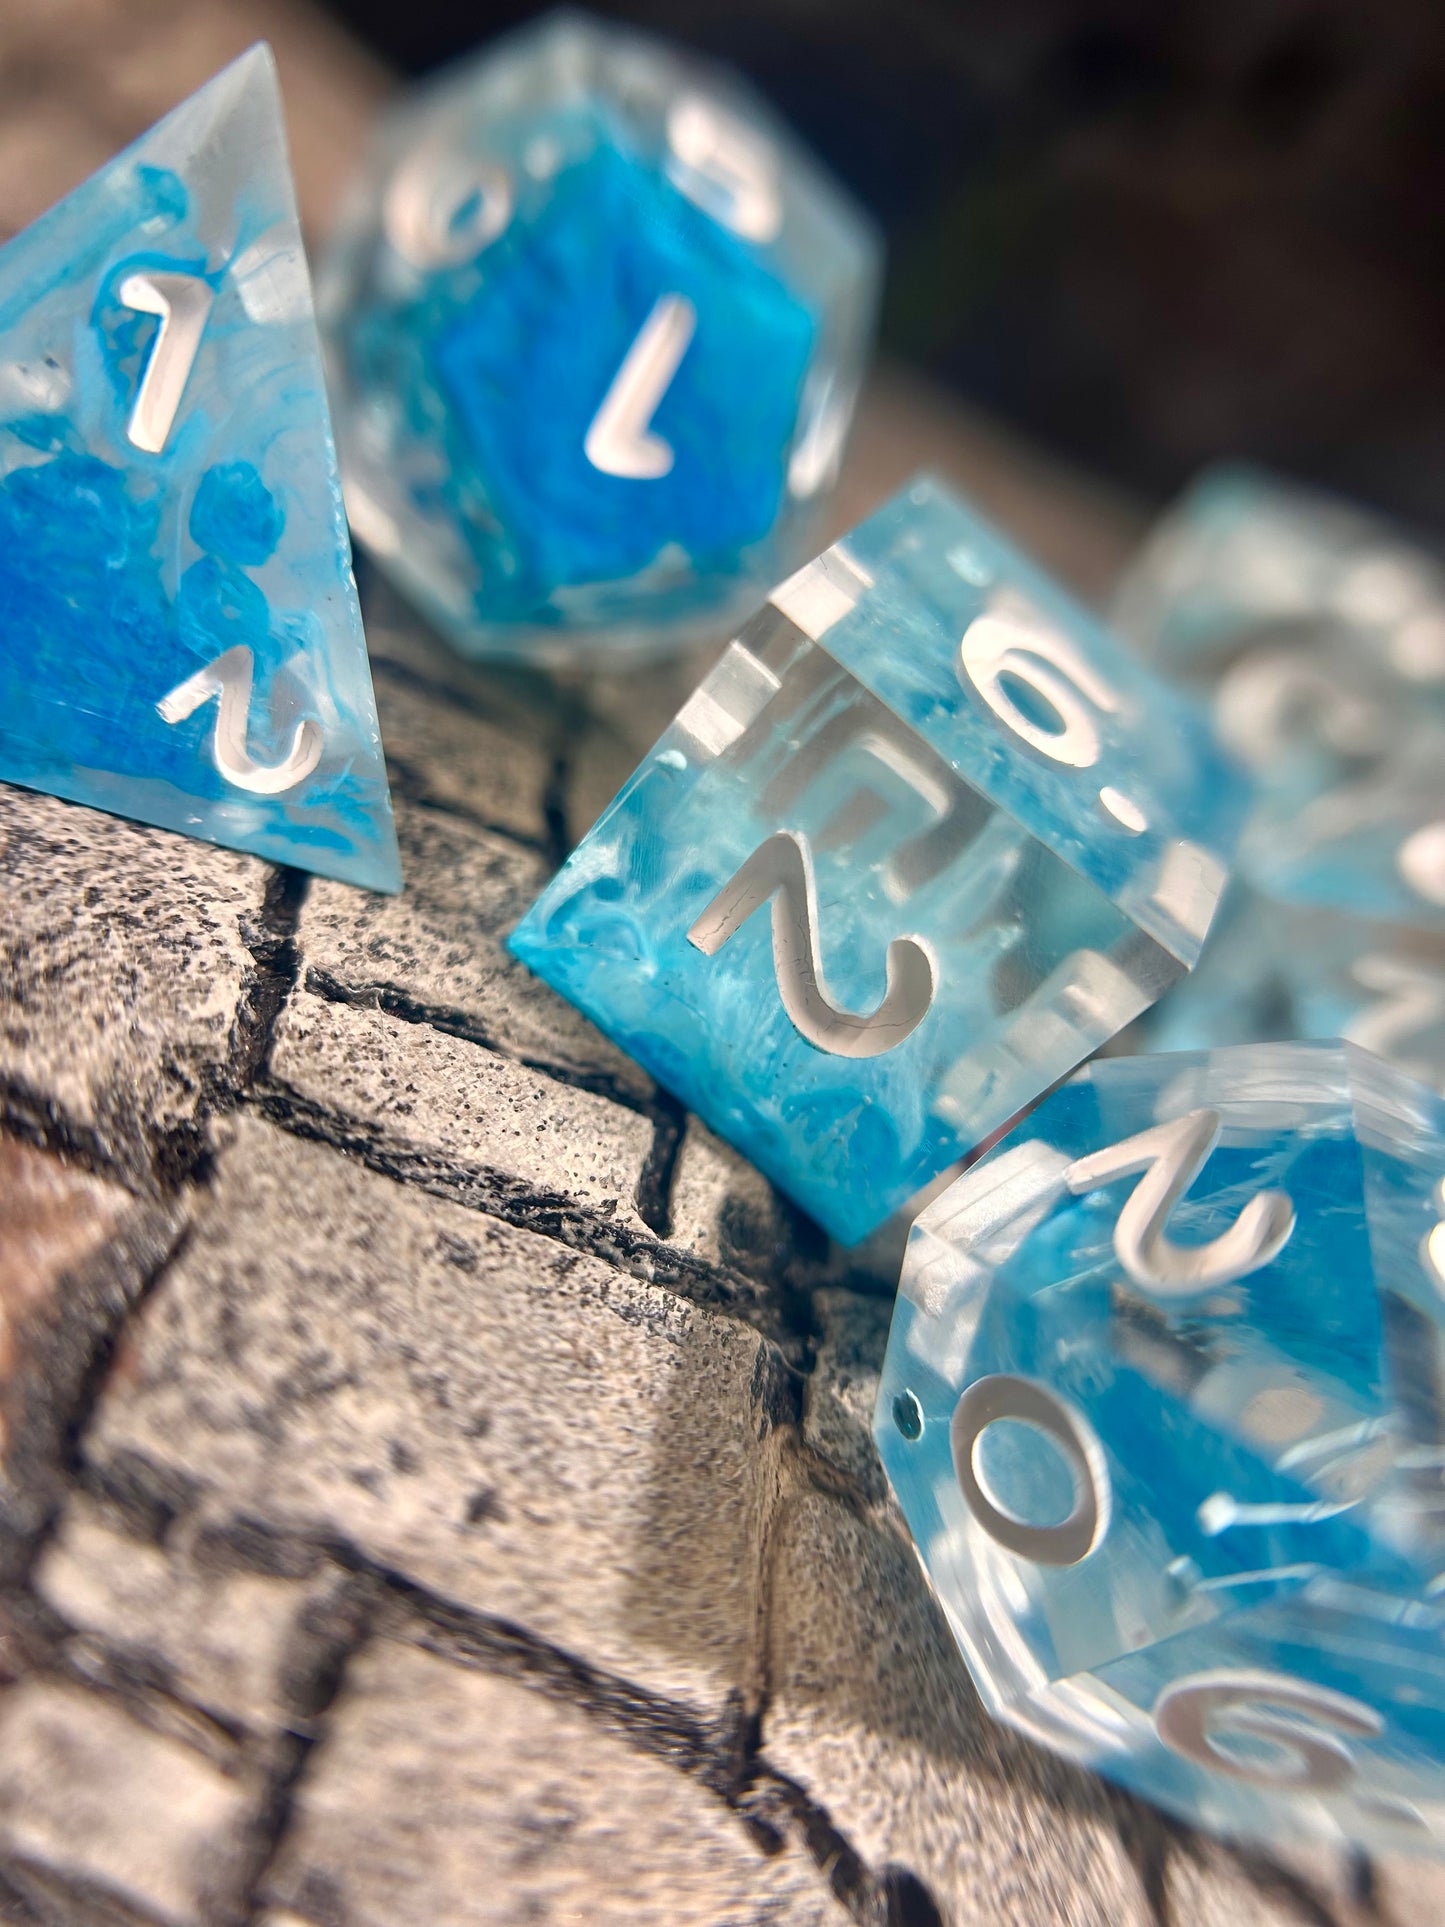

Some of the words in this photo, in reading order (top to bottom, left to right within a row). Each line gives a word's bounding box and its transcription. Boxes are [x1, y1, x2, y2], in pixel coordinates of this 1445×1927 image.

[155, 644, 323, 796] 2
[687, 829, 937, 1059] 2
[1063, 1109, 1298, 1298] 2
